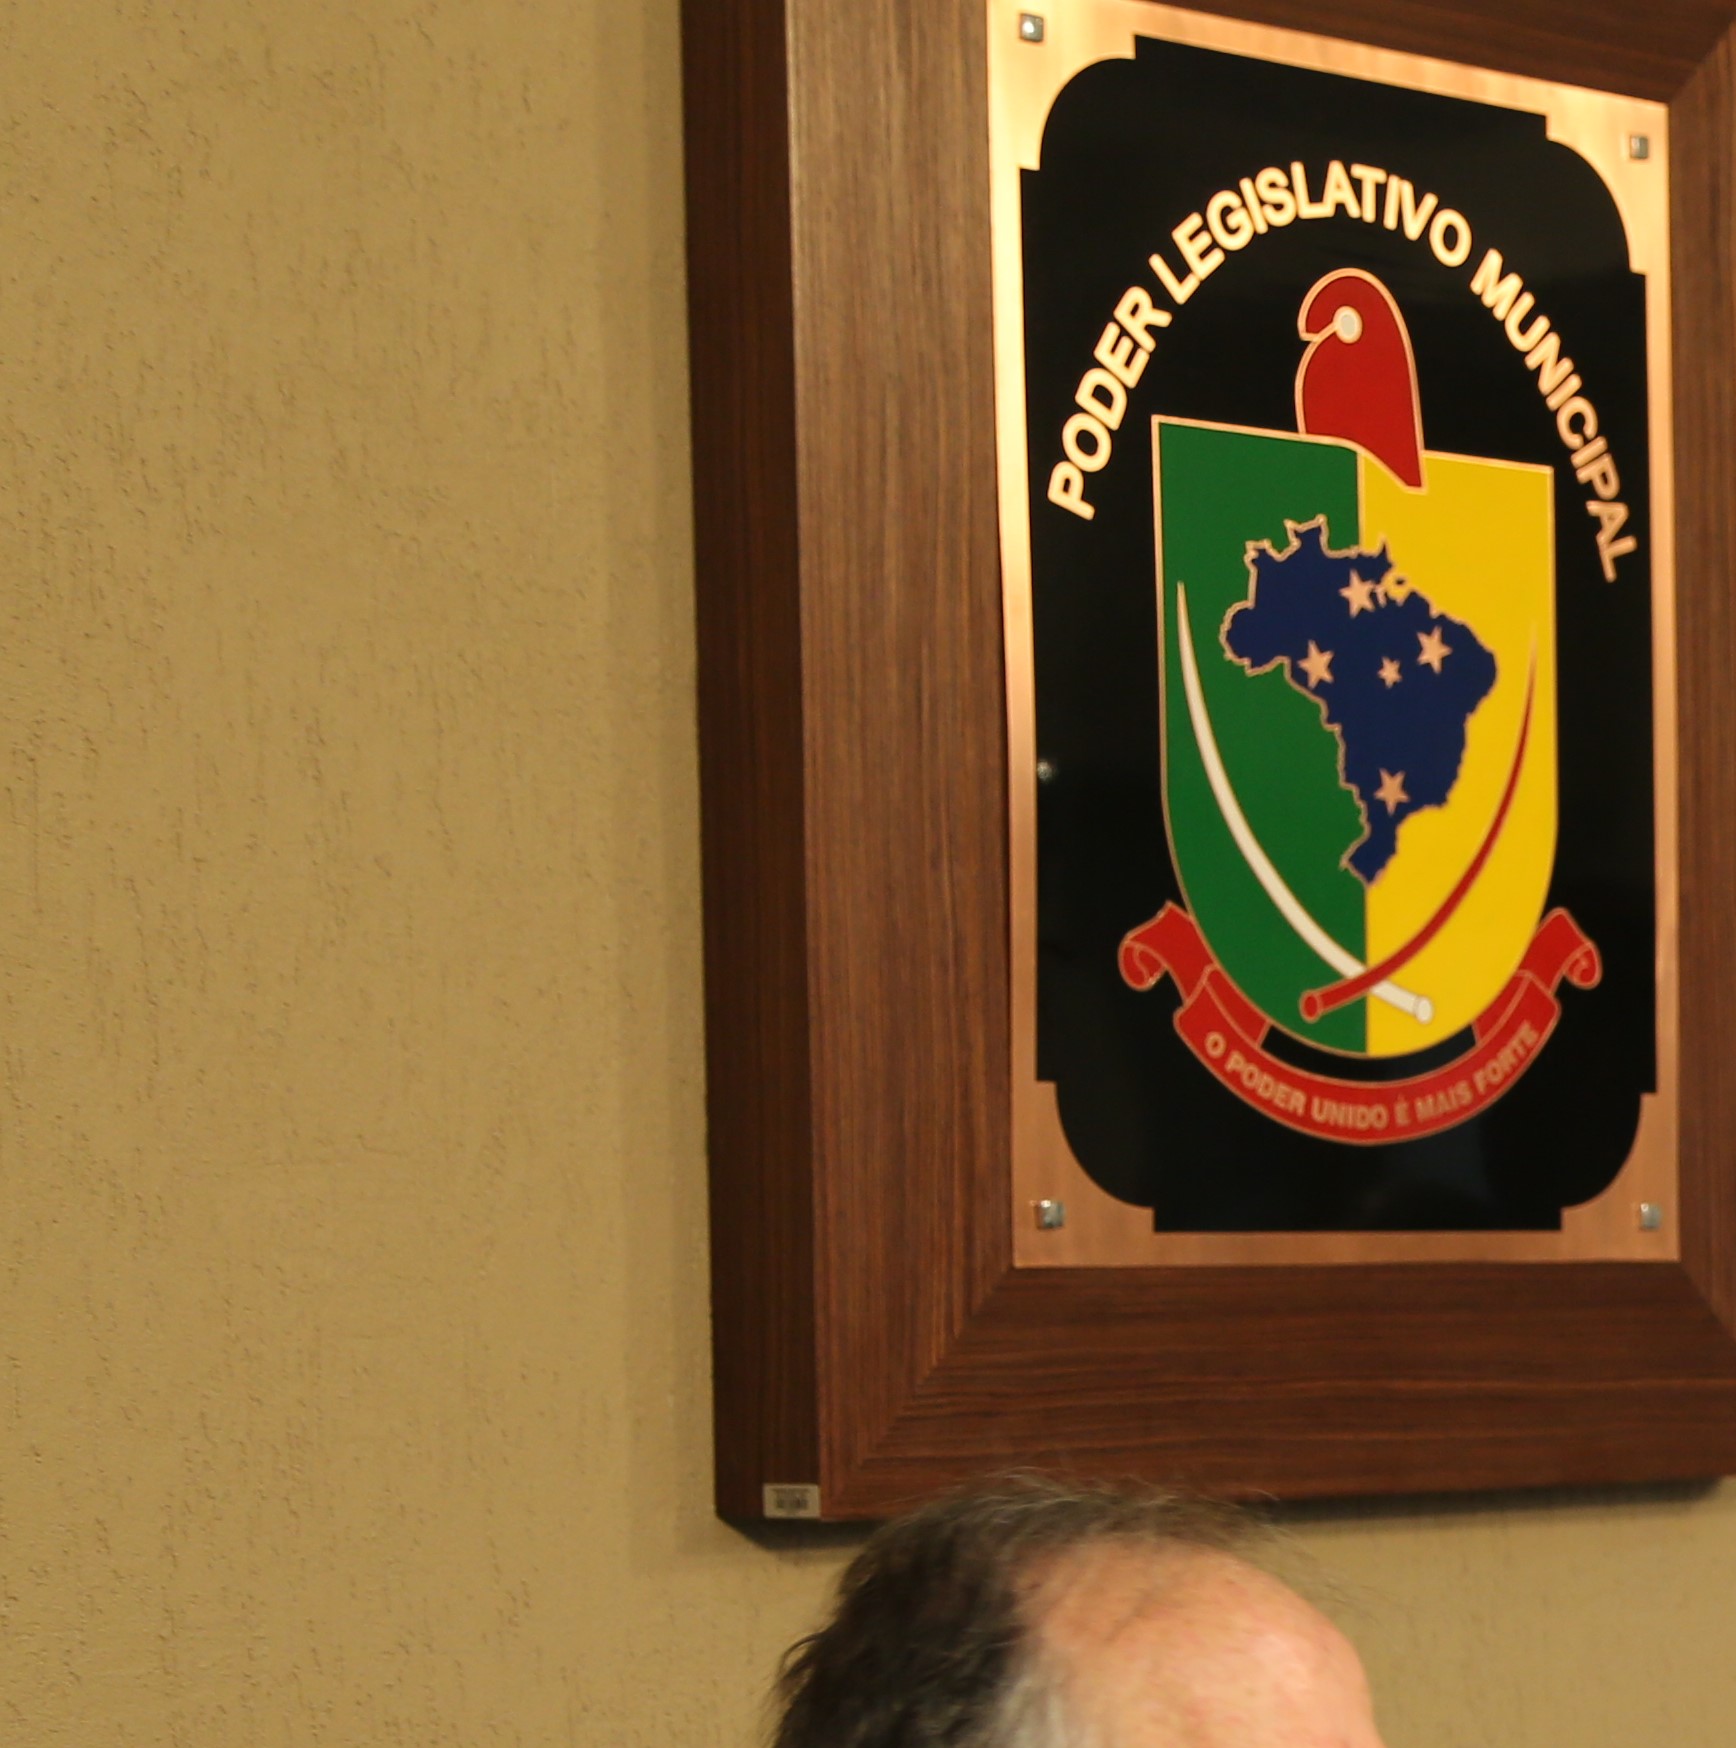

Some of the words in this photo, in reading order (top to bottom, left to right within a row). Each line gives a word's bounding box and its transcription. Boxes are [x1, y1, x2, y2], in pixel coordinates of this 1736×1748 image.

[1047, 286, 1172, 520] PODER
[1149, 160, 1472, 305] LEGISLATIVO
[1470, 249, 1637, 582] MUNICIPAL
[1204, 1031, 1227, 1059] O
[1225, 1052, 1305, 1117] PODER
[1311, 1098, 1388, 1130] UNIDO
[1395, 1095, 1412, 1126] É
[1414, 1081, 1473, 1122] MAIS
[1473, 1020, 1540, 1094] FORTE
